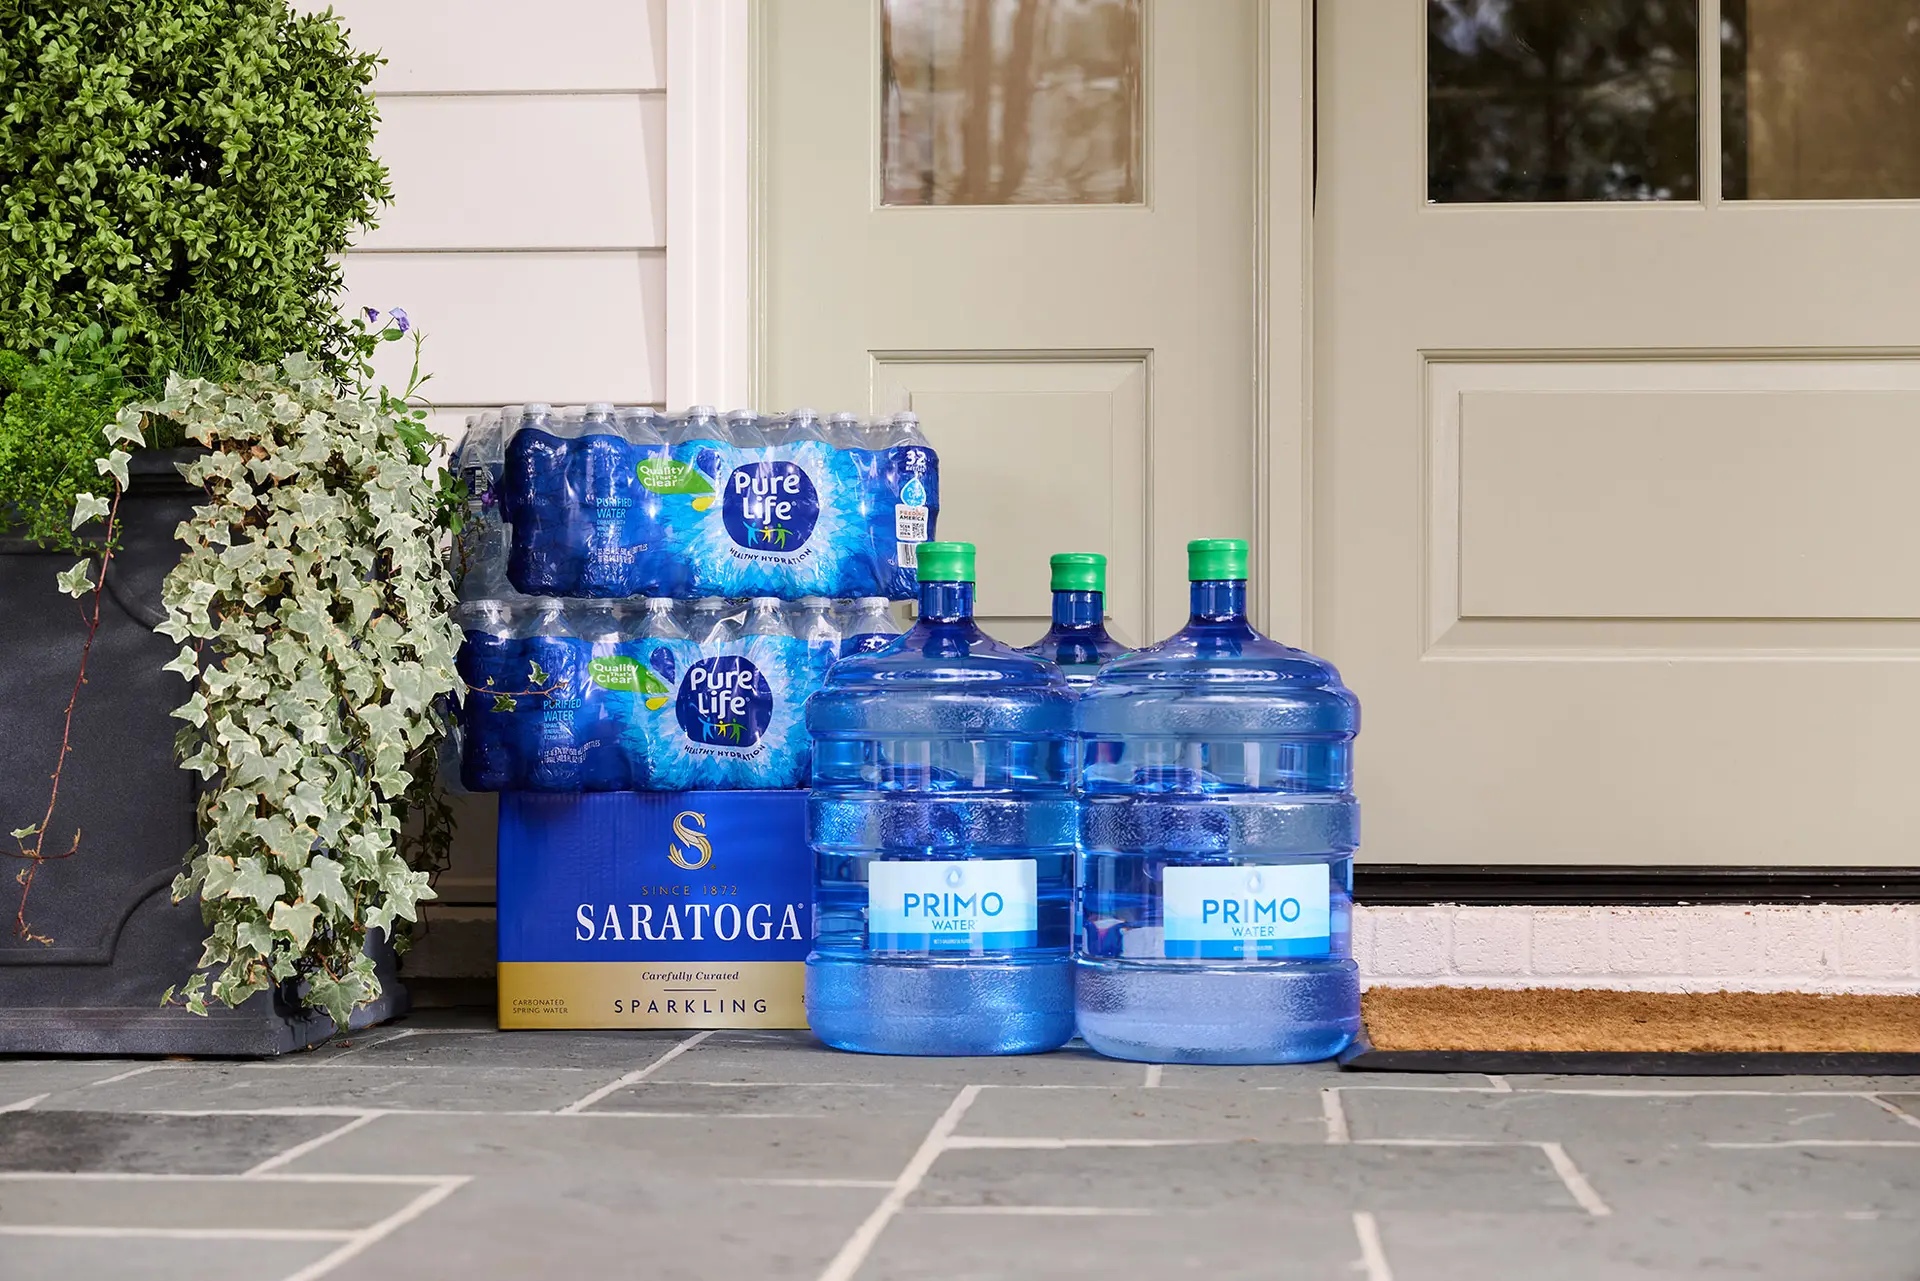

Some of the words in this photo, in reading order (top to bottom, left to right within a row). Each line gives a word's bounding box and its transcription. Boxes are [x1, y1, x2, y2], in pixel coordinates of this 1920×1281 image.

[904, 450, 927, 465] 32
[639, 466, 685, 476] Quality
[643, 478, 678, 487] Clear
[734, 471, 801, 495] Pure
[596, 497, 633, 507] PURIFIED
[596, 508, 627, 518] WATER
[742, 496, 792, 525] Life
[729, 547, 760, 561] HEALTHY
[761, 547, 813, 565] HYDRATION
[593, 663, 639, 673] Quality
[596, 674, 633, 684] Clear
[690, 667, 754, 691] Pure
[543, 698, 582, 710] PURIFIED
[698, 690, 747, 719] Life
[543, 709, 574, 721] WATER
[684, 744, 715, 756] HEALTHY
[717, 744, 766, 762] HYDRATION
[641, 885, 691, 896] SINCE
[703, 885, 738, 896] 1872
[904, 892, 1004, 917] PRIMO
[1202, 897, 1301, 924] PRIMO
[575, 903, 803, 941] SARATOGA
[931, 919, 976, 931] WATER
[1231, 926, 1276, 937] WATER
[641, 971, 693, 982] Carefully
[695, 971, 740, 981] Curated
[614, 999, 768, 1014] SPARKLING
